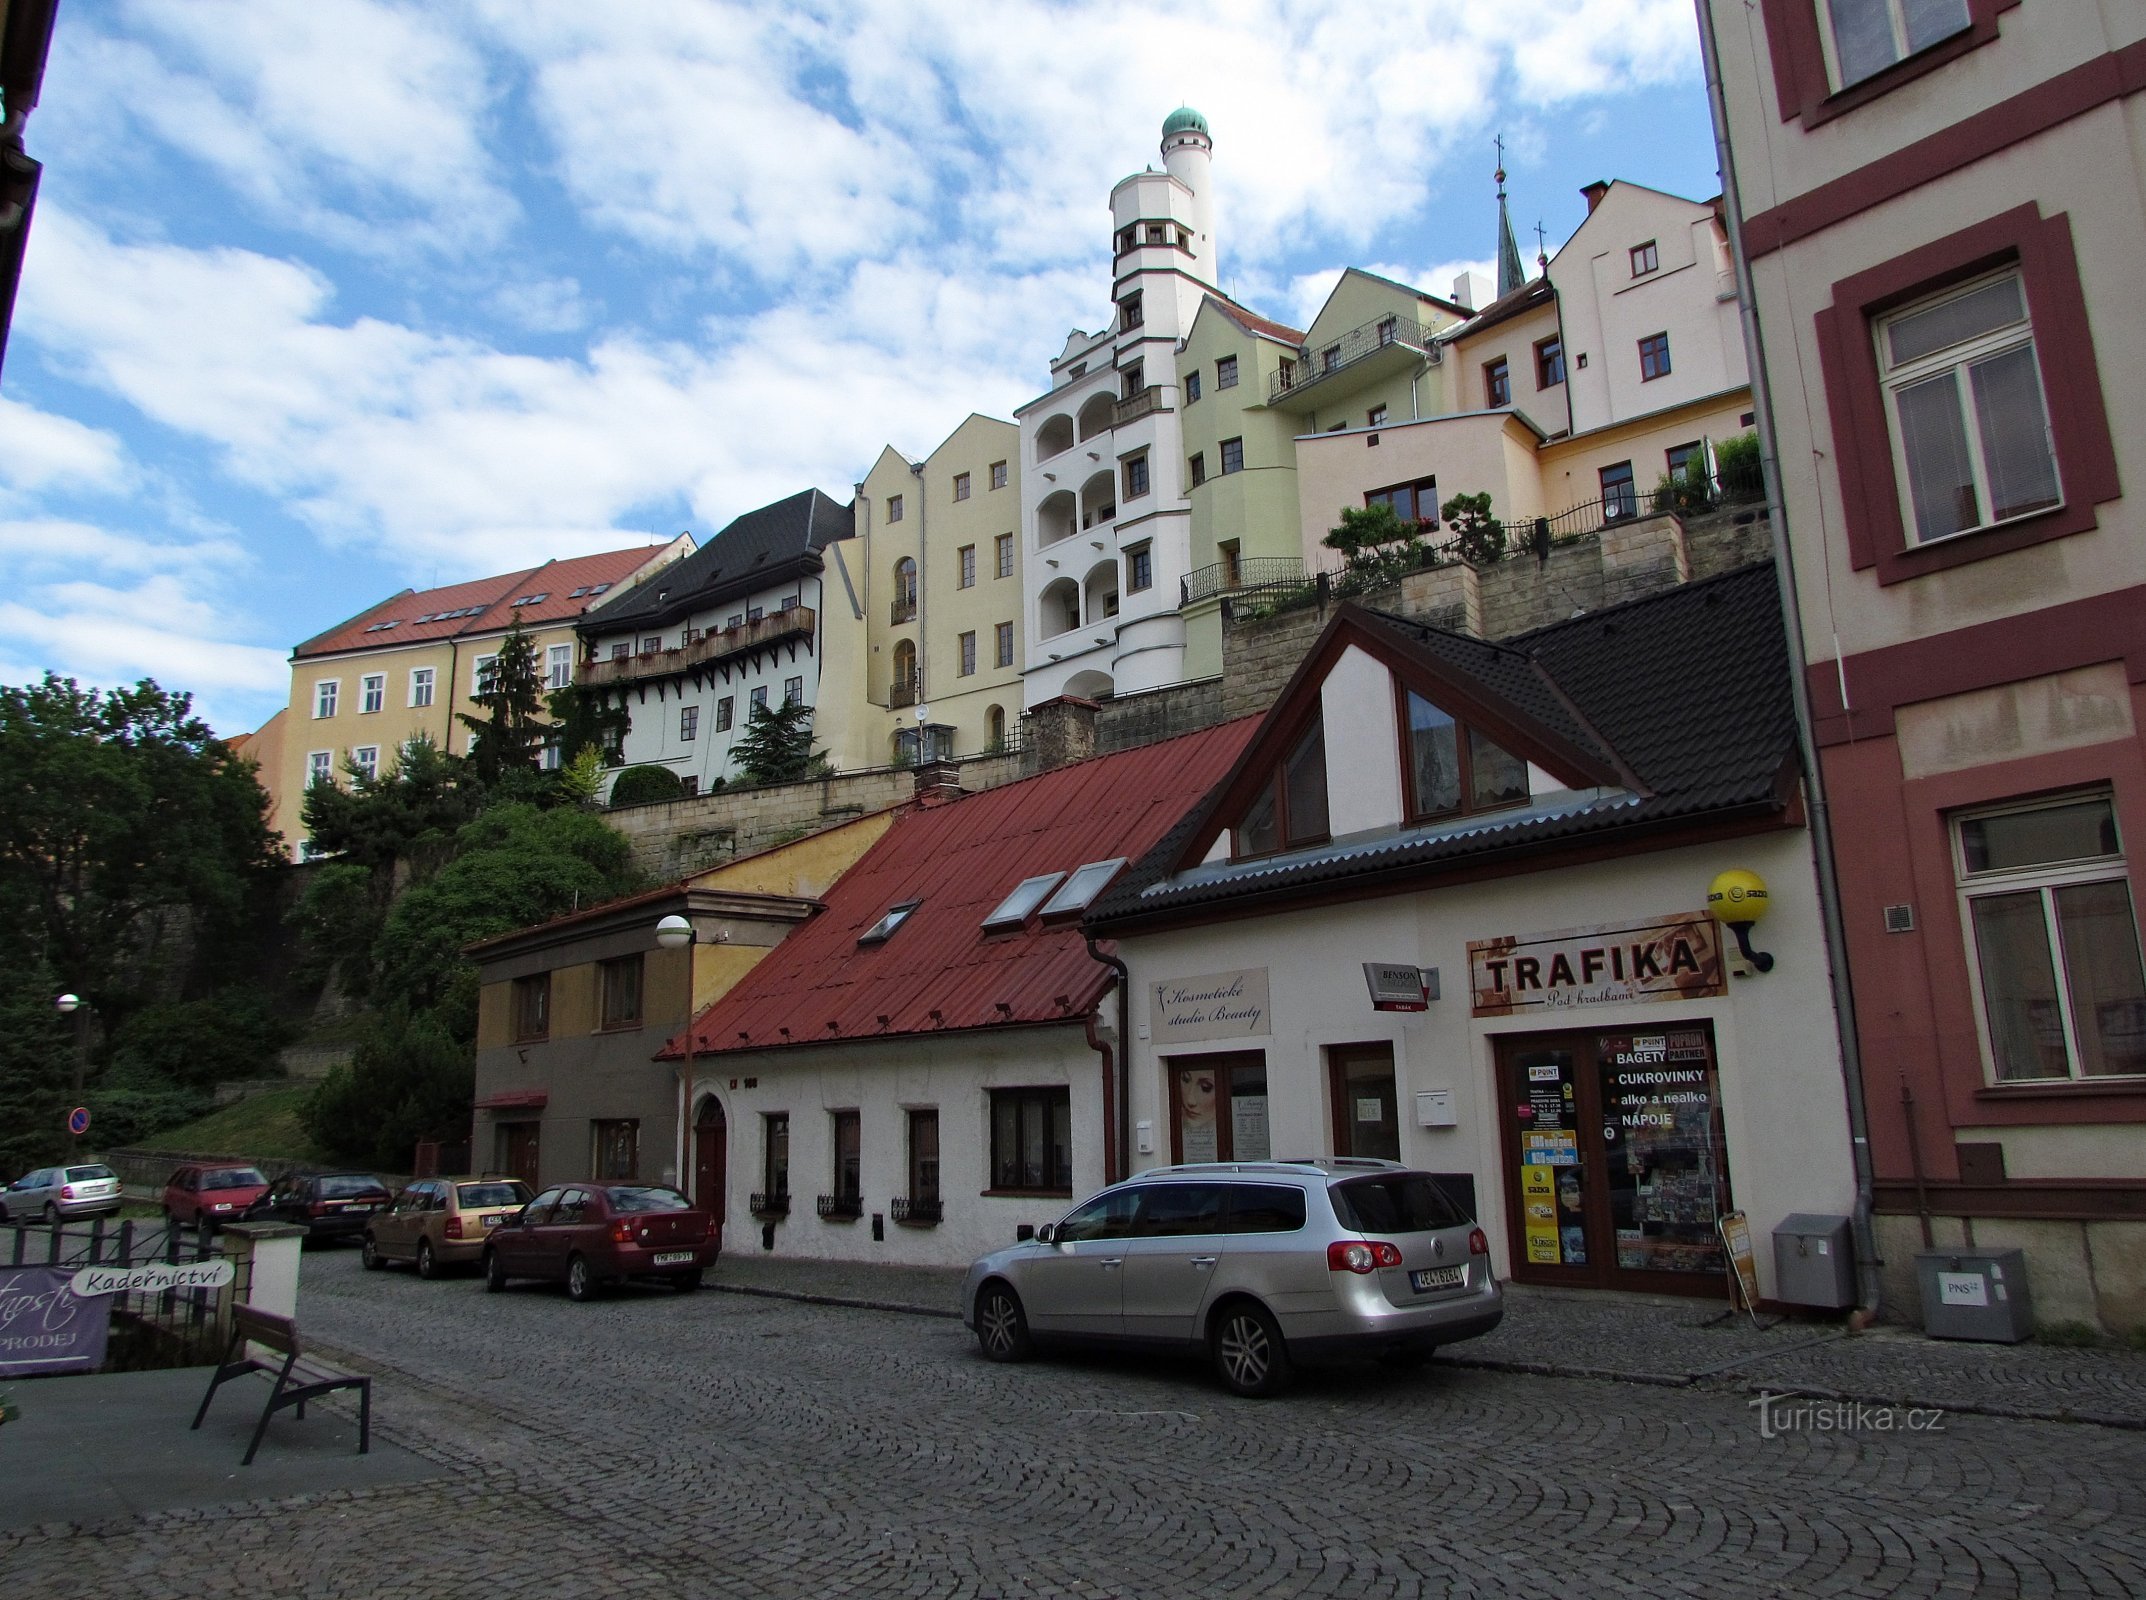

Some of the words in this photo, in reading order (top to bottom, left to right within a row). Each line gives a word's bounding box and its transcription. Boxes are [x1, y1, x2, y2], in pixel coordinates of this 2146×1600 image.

[1485, 936, 1703, 995] TRAFIKA
[1382, 970, 1416, 980] BENSON
[1167, 975, 1244, 1005] Kosmetické
[1547, 989, 1570, 1007] Pod
[1577, 986, 1633, 1004] hradbami
[1168, 1007, 1205, 1026] studio
[1208, 1005, 1261, 1031] Beauty
[1616, 1051, 1665, 1064] BAGETY
[1669, 1049, 1705, 1060] PARTNER
[1618, 1069, 1704, 1085] CUKROVINKY
[1620, 1092, 1647, 1106] alko
[1651, 1095, 1660, 1105] a
[1663, 1091, 1707, 1104] nealko
[1622, 1112, 1673, 1127] NÁPOJE
[86, 1266, 223, 1291] Kadeřnictví
[1420, 1271, 1435, 1286] 4E4
[1948, 1282, 1970, 1294] PNS
